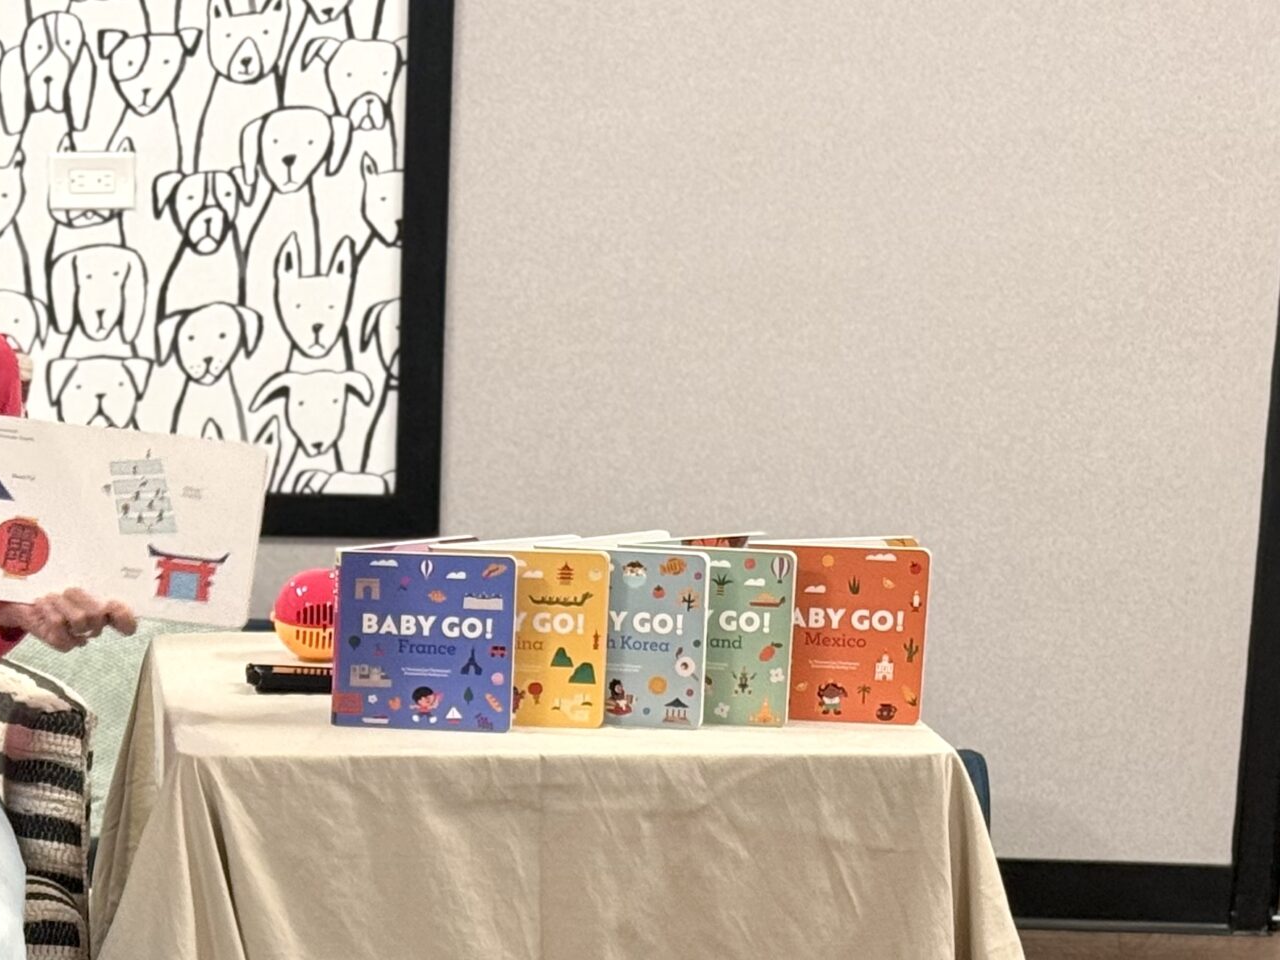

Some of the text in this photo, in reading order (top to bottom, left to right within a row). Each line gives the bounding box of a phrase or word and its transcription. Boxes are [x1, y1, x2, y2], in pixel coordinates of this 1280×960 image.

[361, 613, 436, 637] BABY
[441, 616, 493, 640] GO!
[532, 611, 585, 635] GO!
[632, 611, 684, 635] GO!
[719, 610, 771, 634] GO!
[793, 607, 905, 632] ABY GO!
[398, 639, 456, 656] France
[517, 636, 545, 651] ina
[620, 635, 670, 652] Korea
[804, 631, 867, 649] Mexico
